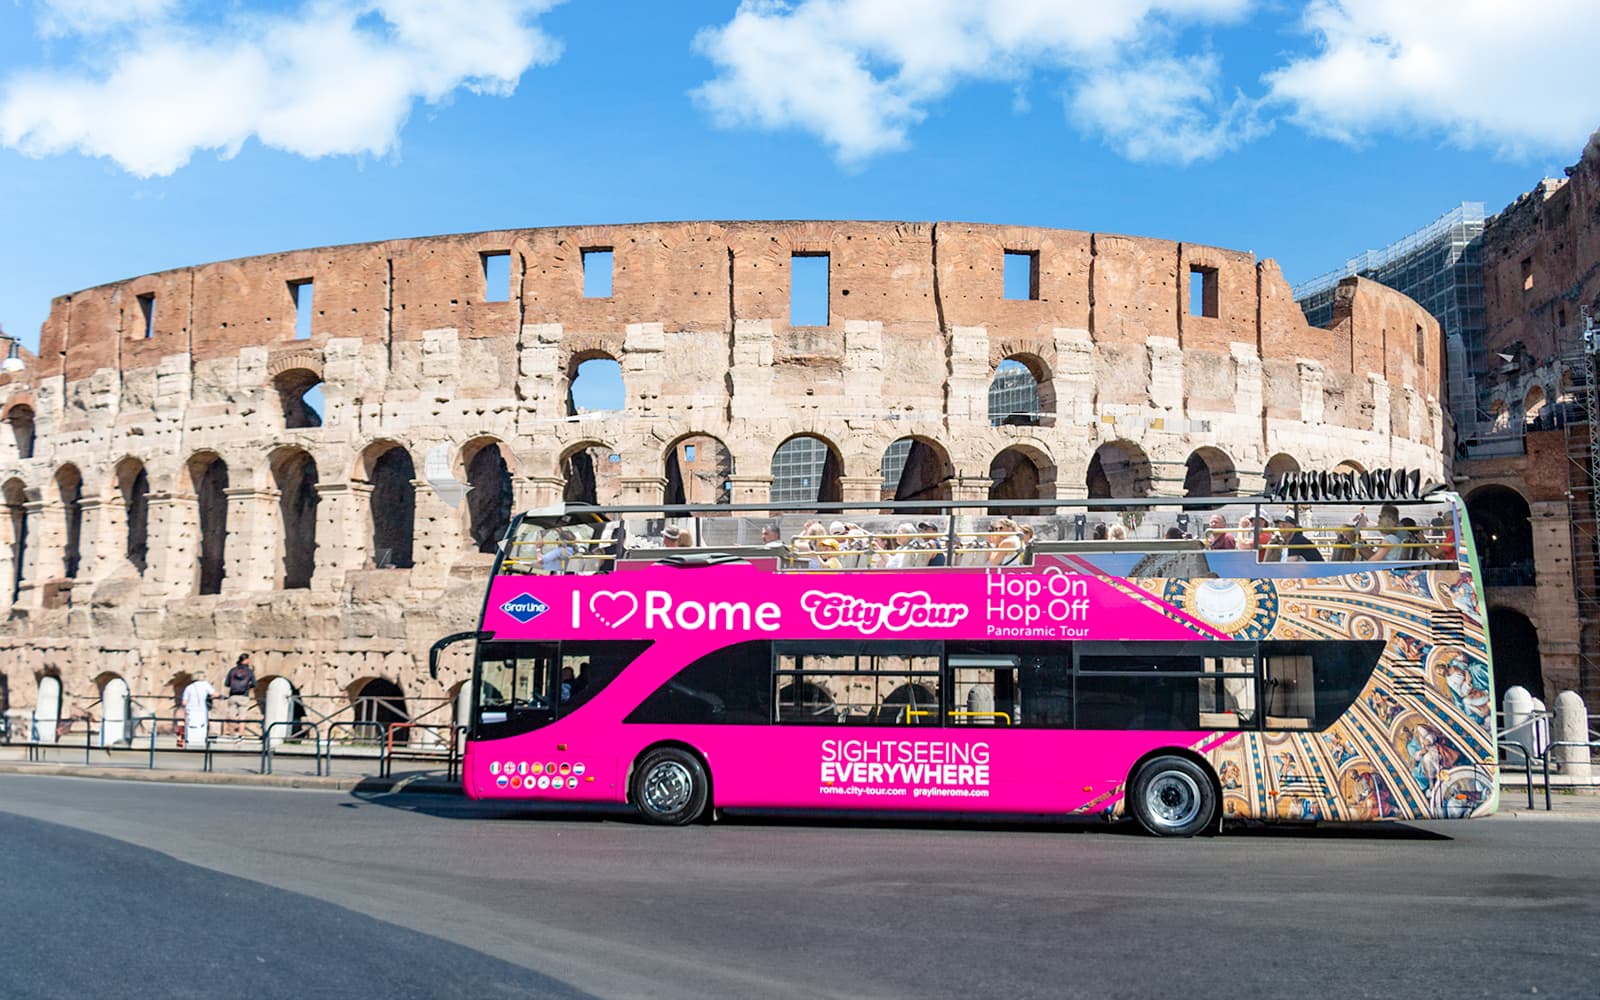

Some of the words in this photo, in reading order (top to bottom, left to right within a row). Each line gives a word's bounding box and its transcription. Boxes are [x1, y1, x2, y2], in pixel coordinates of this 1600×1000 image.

[572, 590, 581, 628] I
[645, 590, 782, 631] Rome
[801, 589, 883, 635] City
[884, 590, 969, 632] Tour
[986, 624, 1056, 637] Panoramic
[1059, 625, 1089, 637] Tour
[821, 740, 990, 764] SIGHTSEEING
[820, 762, 990, 785] EVERYWHERE
[819, 785, 907, 797] roma.city-tour.com
[913, 787, 990, 798] graylinerome.com
